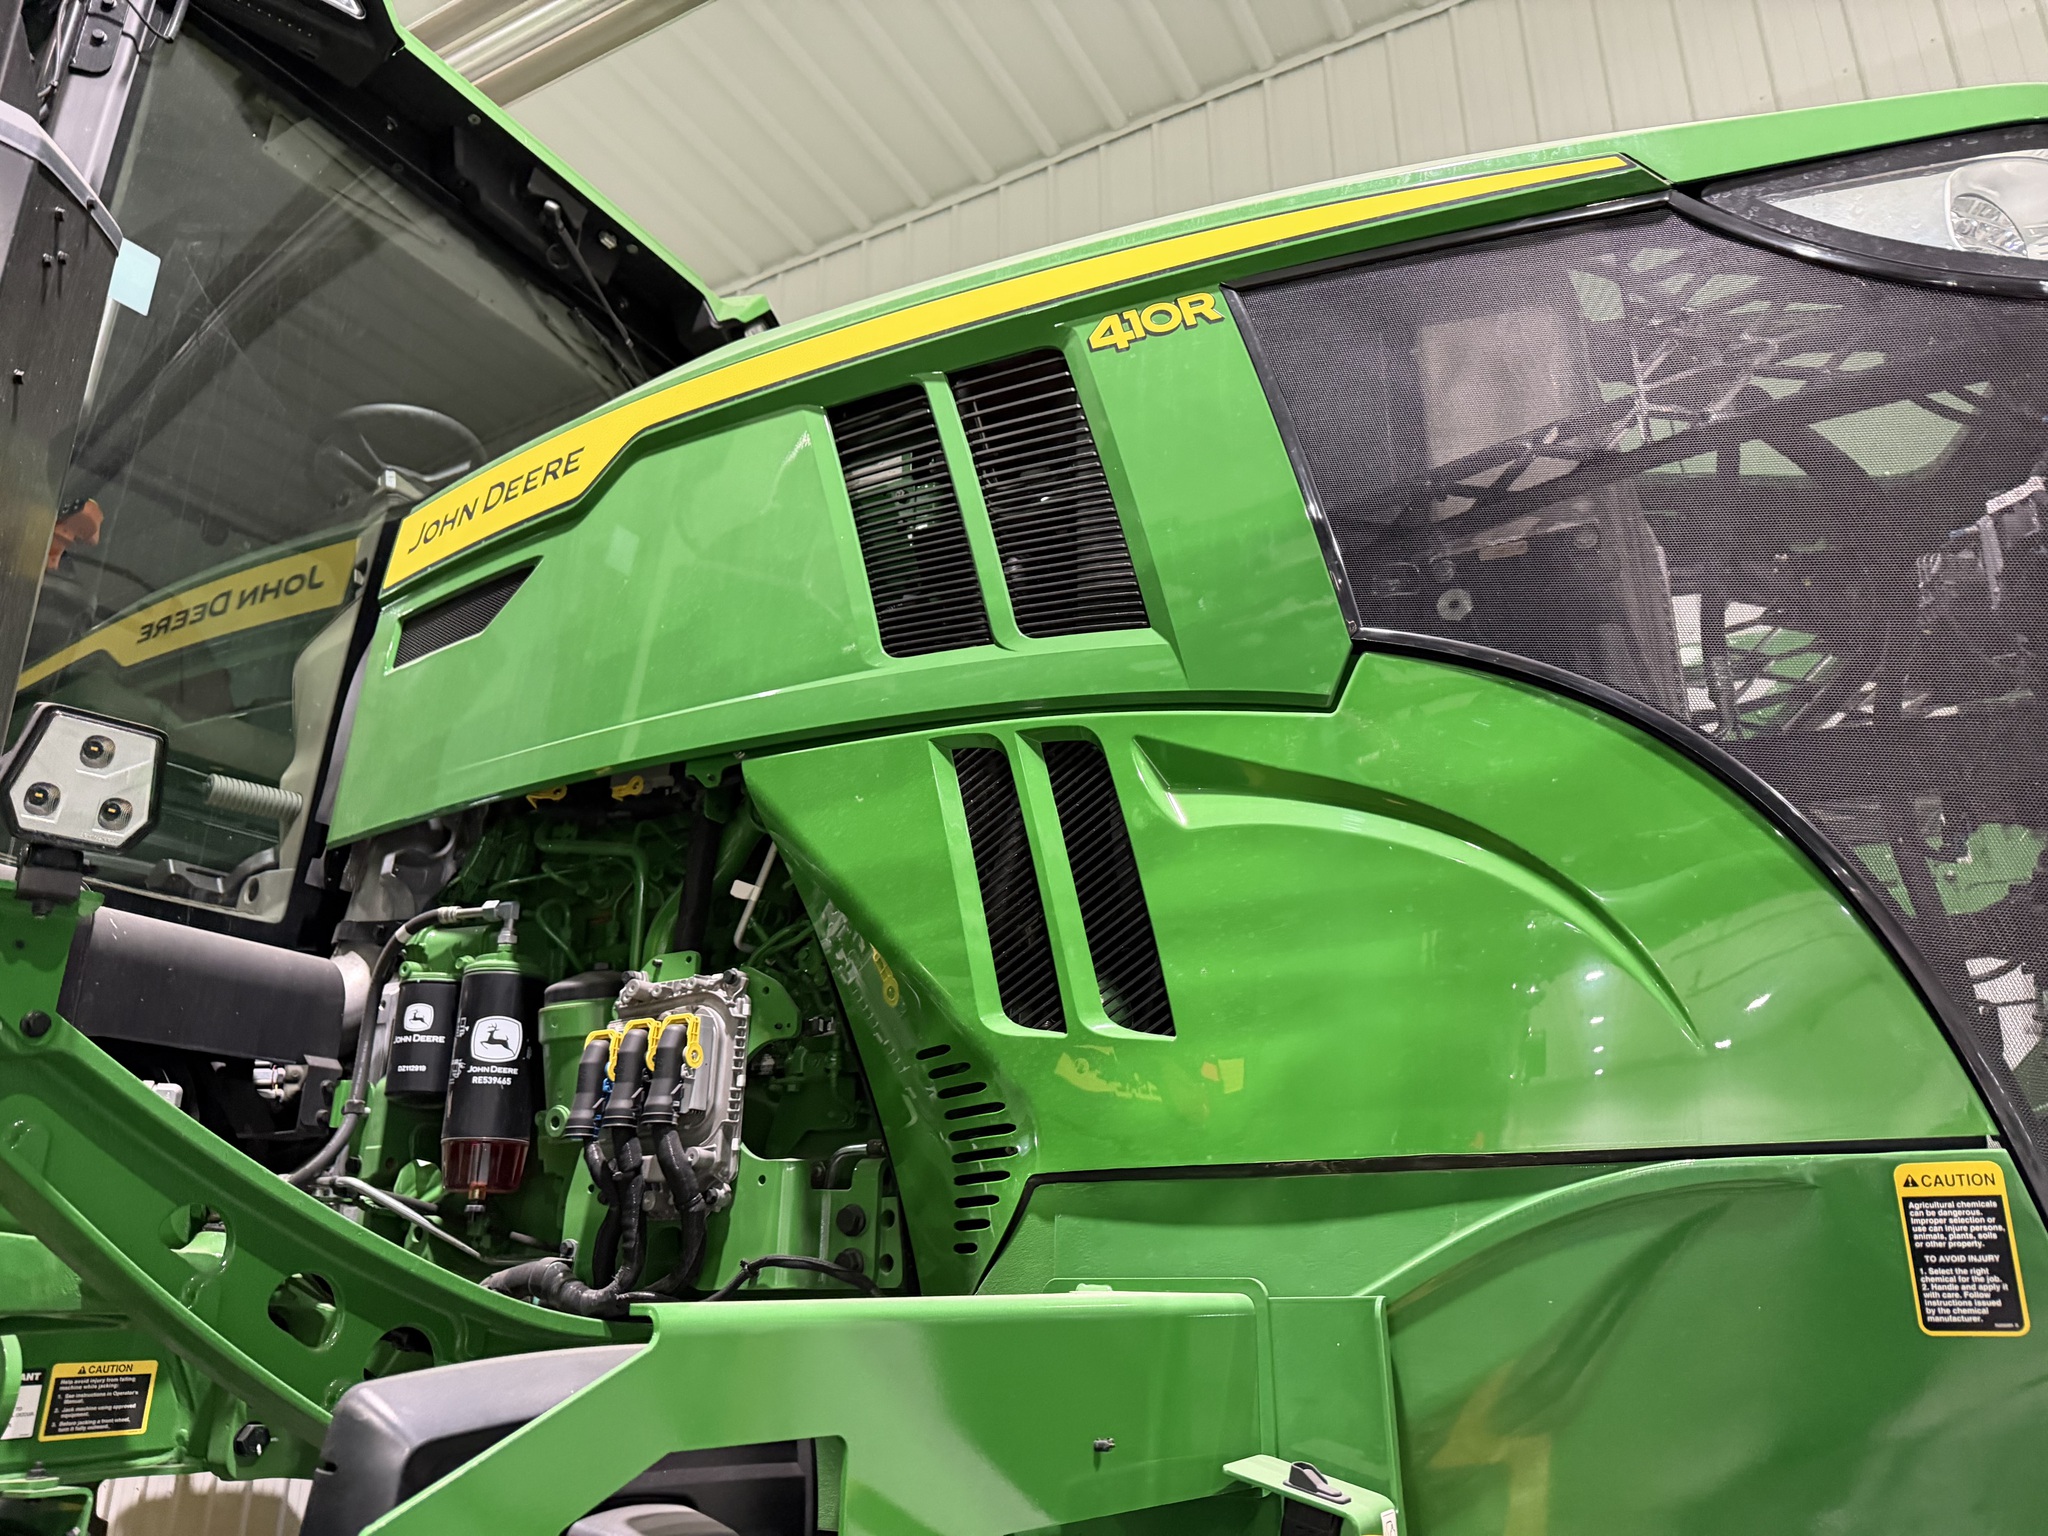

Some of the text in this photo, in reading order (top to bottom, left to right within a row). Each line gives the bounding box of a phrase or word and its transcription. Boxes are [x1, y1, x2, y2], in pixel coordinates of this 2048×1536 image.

[1087, 292, 1225, 353] 410R
[407, 446, 585, 554] JOHN DEERE
[393, 1034, 445, 1044] JOHN DEERE
[467, 1065, 518, 1075] JOHN DEERE
[472, 1076, 512, 1086] RE539465
[1921, 1173, 1996, 1187] CAUTION
[1909, 1200, 1997, 1210] Agricultural chemicals
[1938, 1209, 1983, 1218] dangerous.
[1945, 1225, 1968, 1234] injure
[1970, 1225, 2005, 1233] persons,
[1948, 1241, 1985, 1249] property.
[1924, 1255, 1937, 1263] TO
[1939, 1255, 1966, 1263] AVOID
[1970, 1267, 1989, 1276] right
[1978, 1283, 2000, 1292] apply
[2002, 1283, 2009, 1291] it
[1926, 1308, 1935, 1316] by
[89, 1364, 133, 1373] CAUTION
